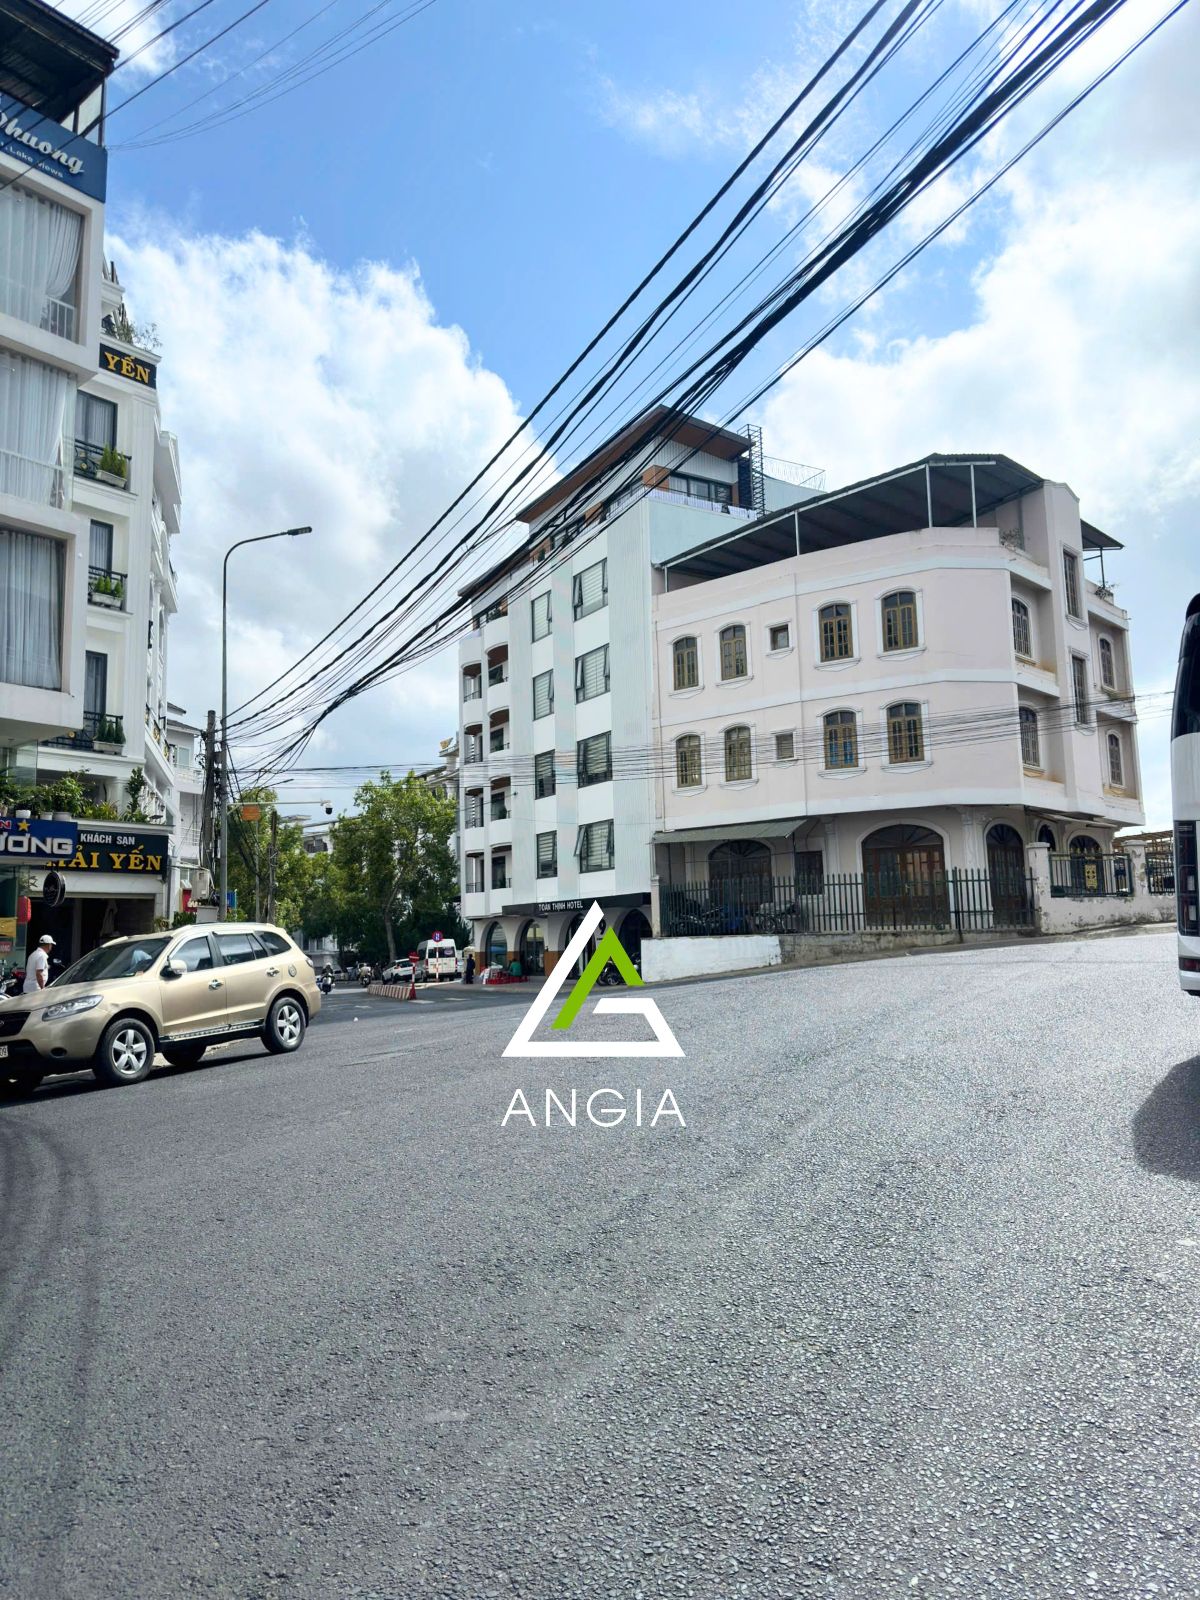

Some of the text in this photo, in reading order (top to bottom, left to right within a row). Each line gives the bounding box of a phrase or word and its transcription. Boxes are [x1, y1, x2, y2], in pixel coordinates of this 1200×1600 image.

[10, 146, 33, 163] Lake
[104, 351, 151, 384] YẾN
[80, 832, 136, 847] KHÁCH SẠN
[46, 844, 163, 871] ẢI YẾN
[566, 900, 583, 910] HOTEL
